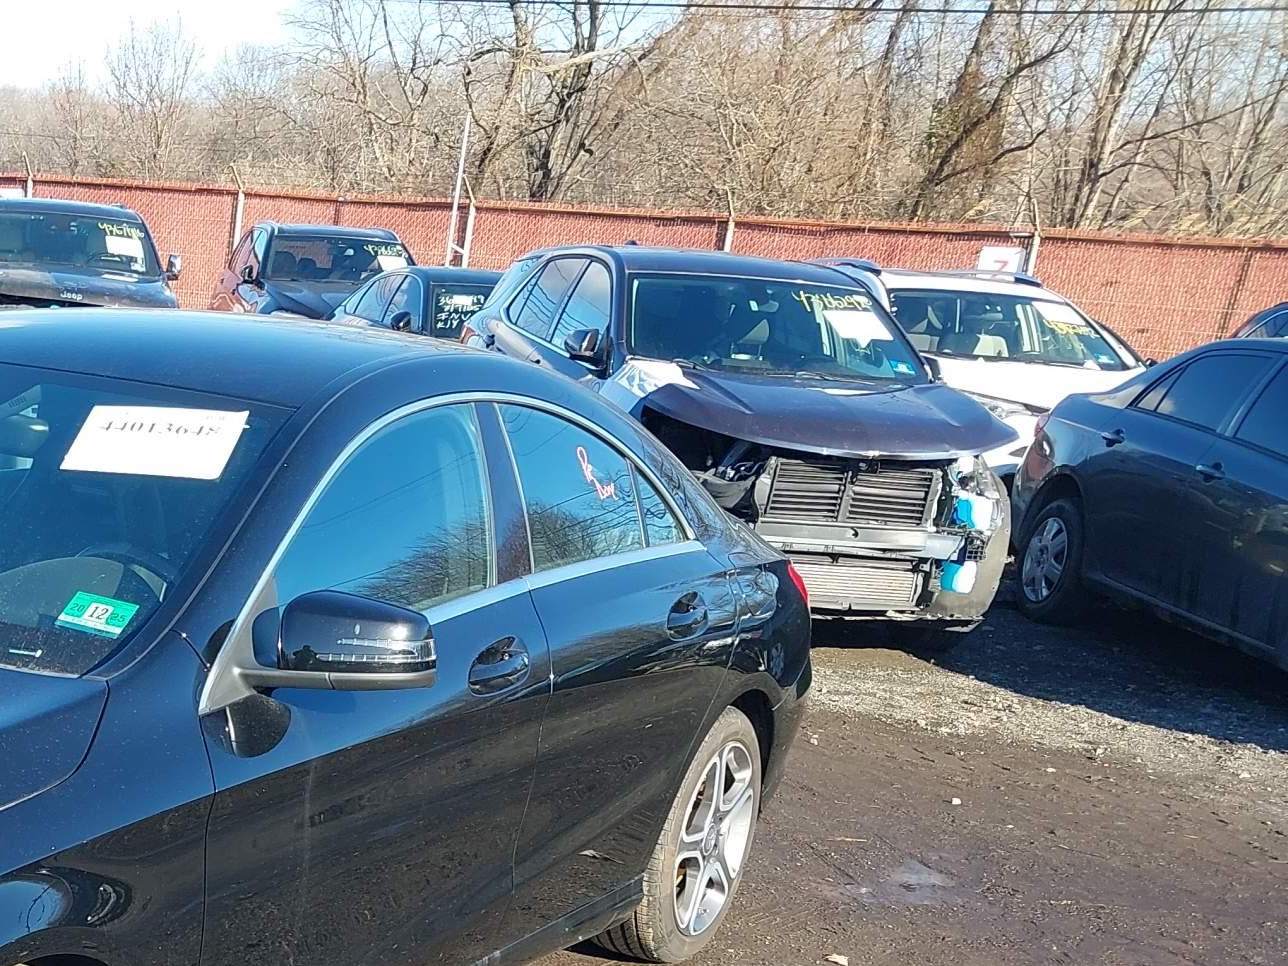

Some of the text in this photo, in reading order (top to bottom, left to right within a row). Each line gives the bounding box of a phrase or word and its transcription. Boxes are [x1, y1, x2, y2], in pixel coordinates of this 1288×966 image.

[60, 291, 83, 301] Jeep
[70, 602, 126, 623] 20 12 25
